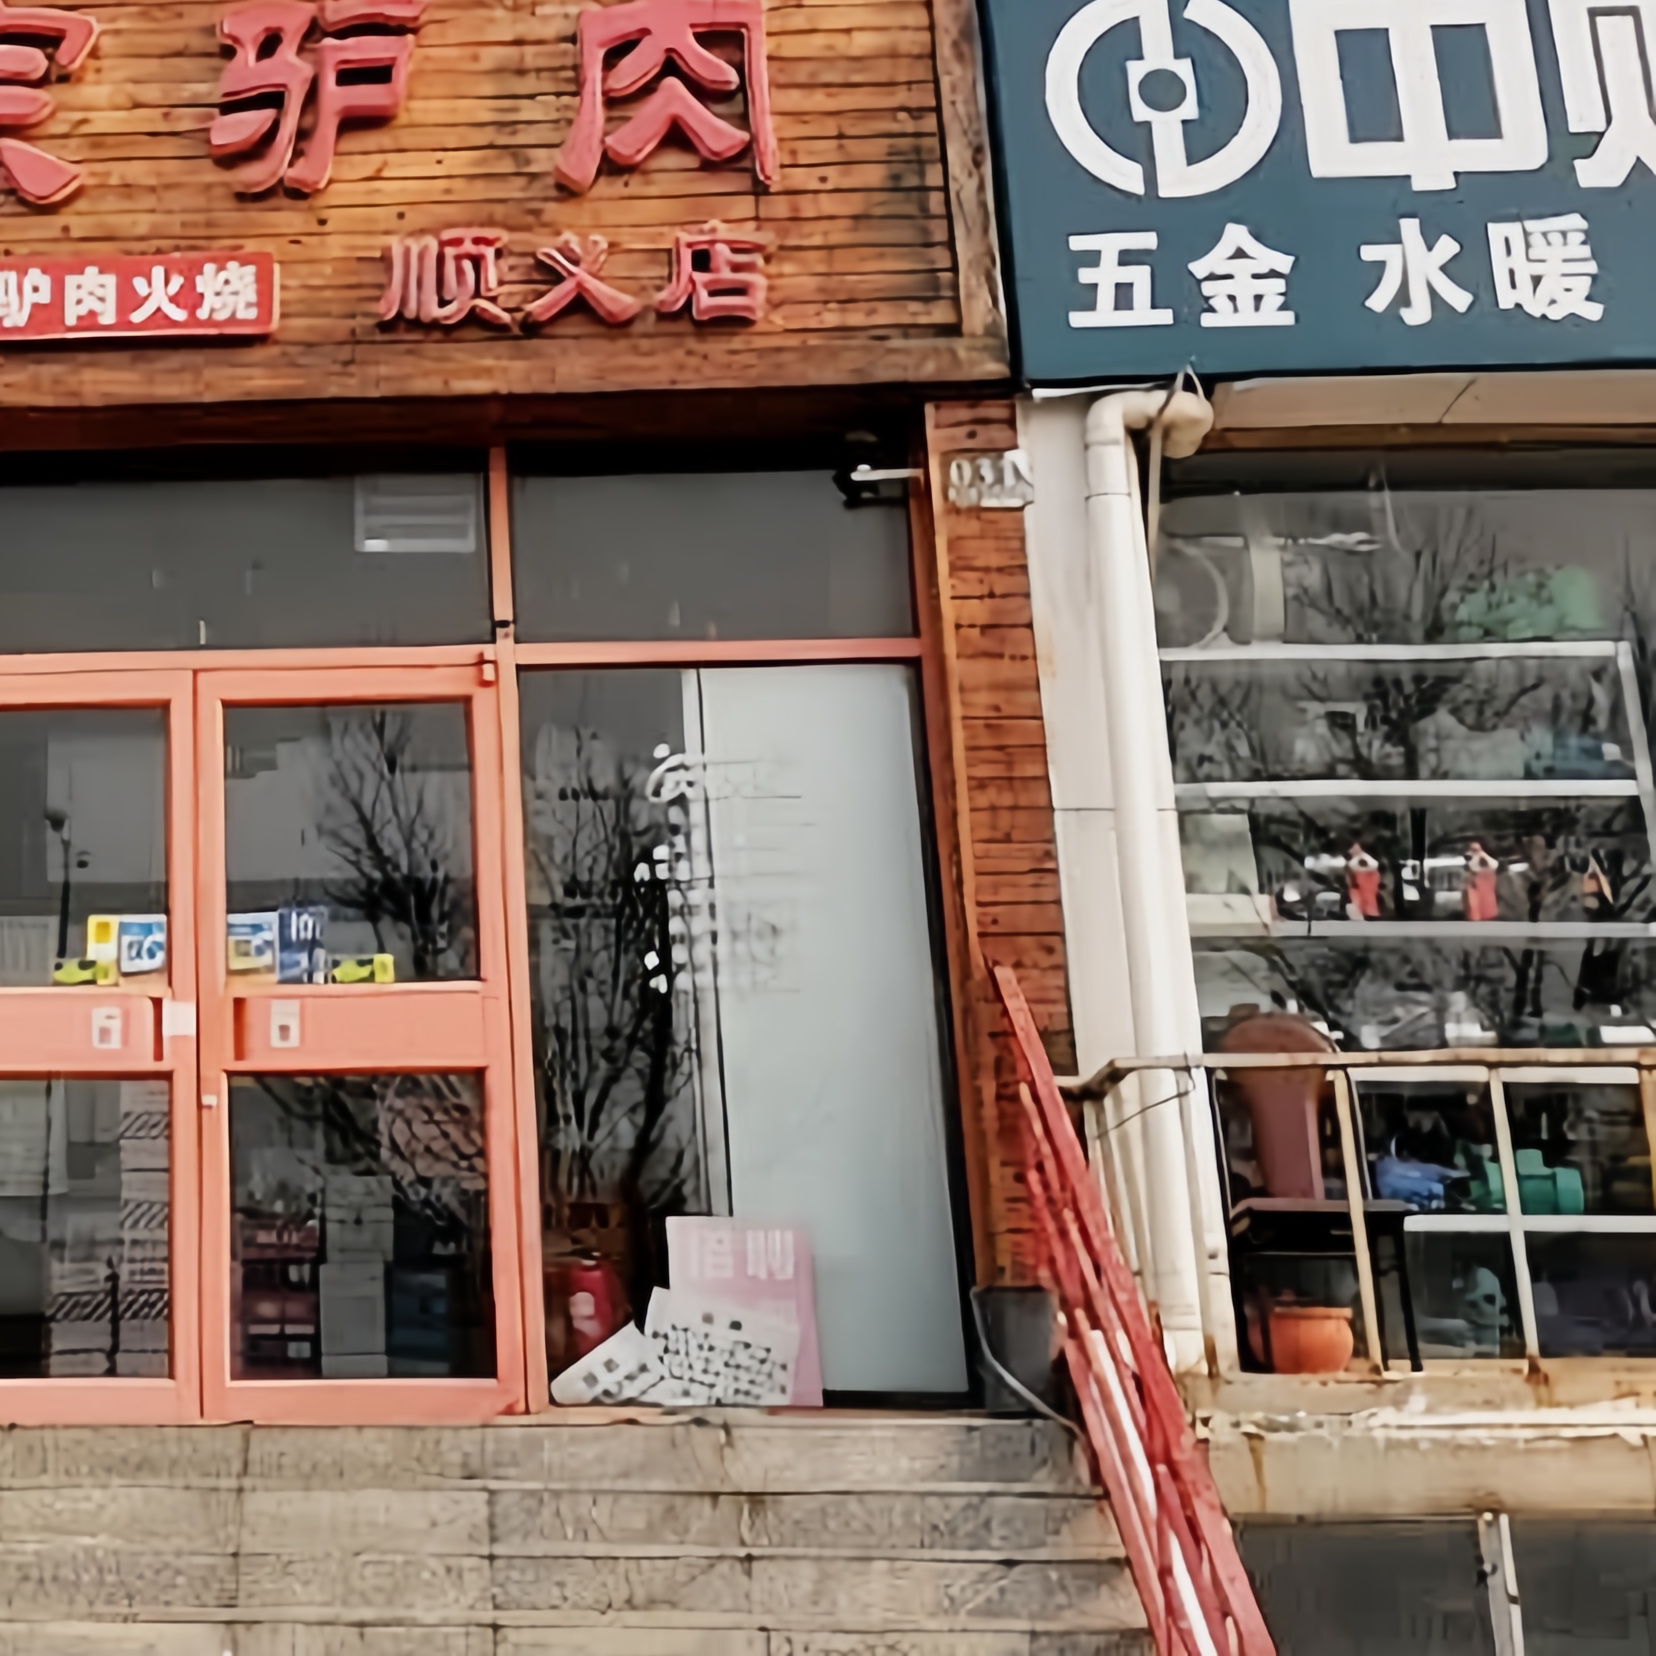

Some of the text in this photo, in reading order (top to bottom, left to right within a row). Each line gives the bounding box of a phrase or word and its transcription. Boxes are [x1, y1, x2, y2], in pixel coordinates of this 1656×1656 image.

[379, 219, 772, 327] 顺义店
[1068, 213, 1605, 328] 五金 水暖
